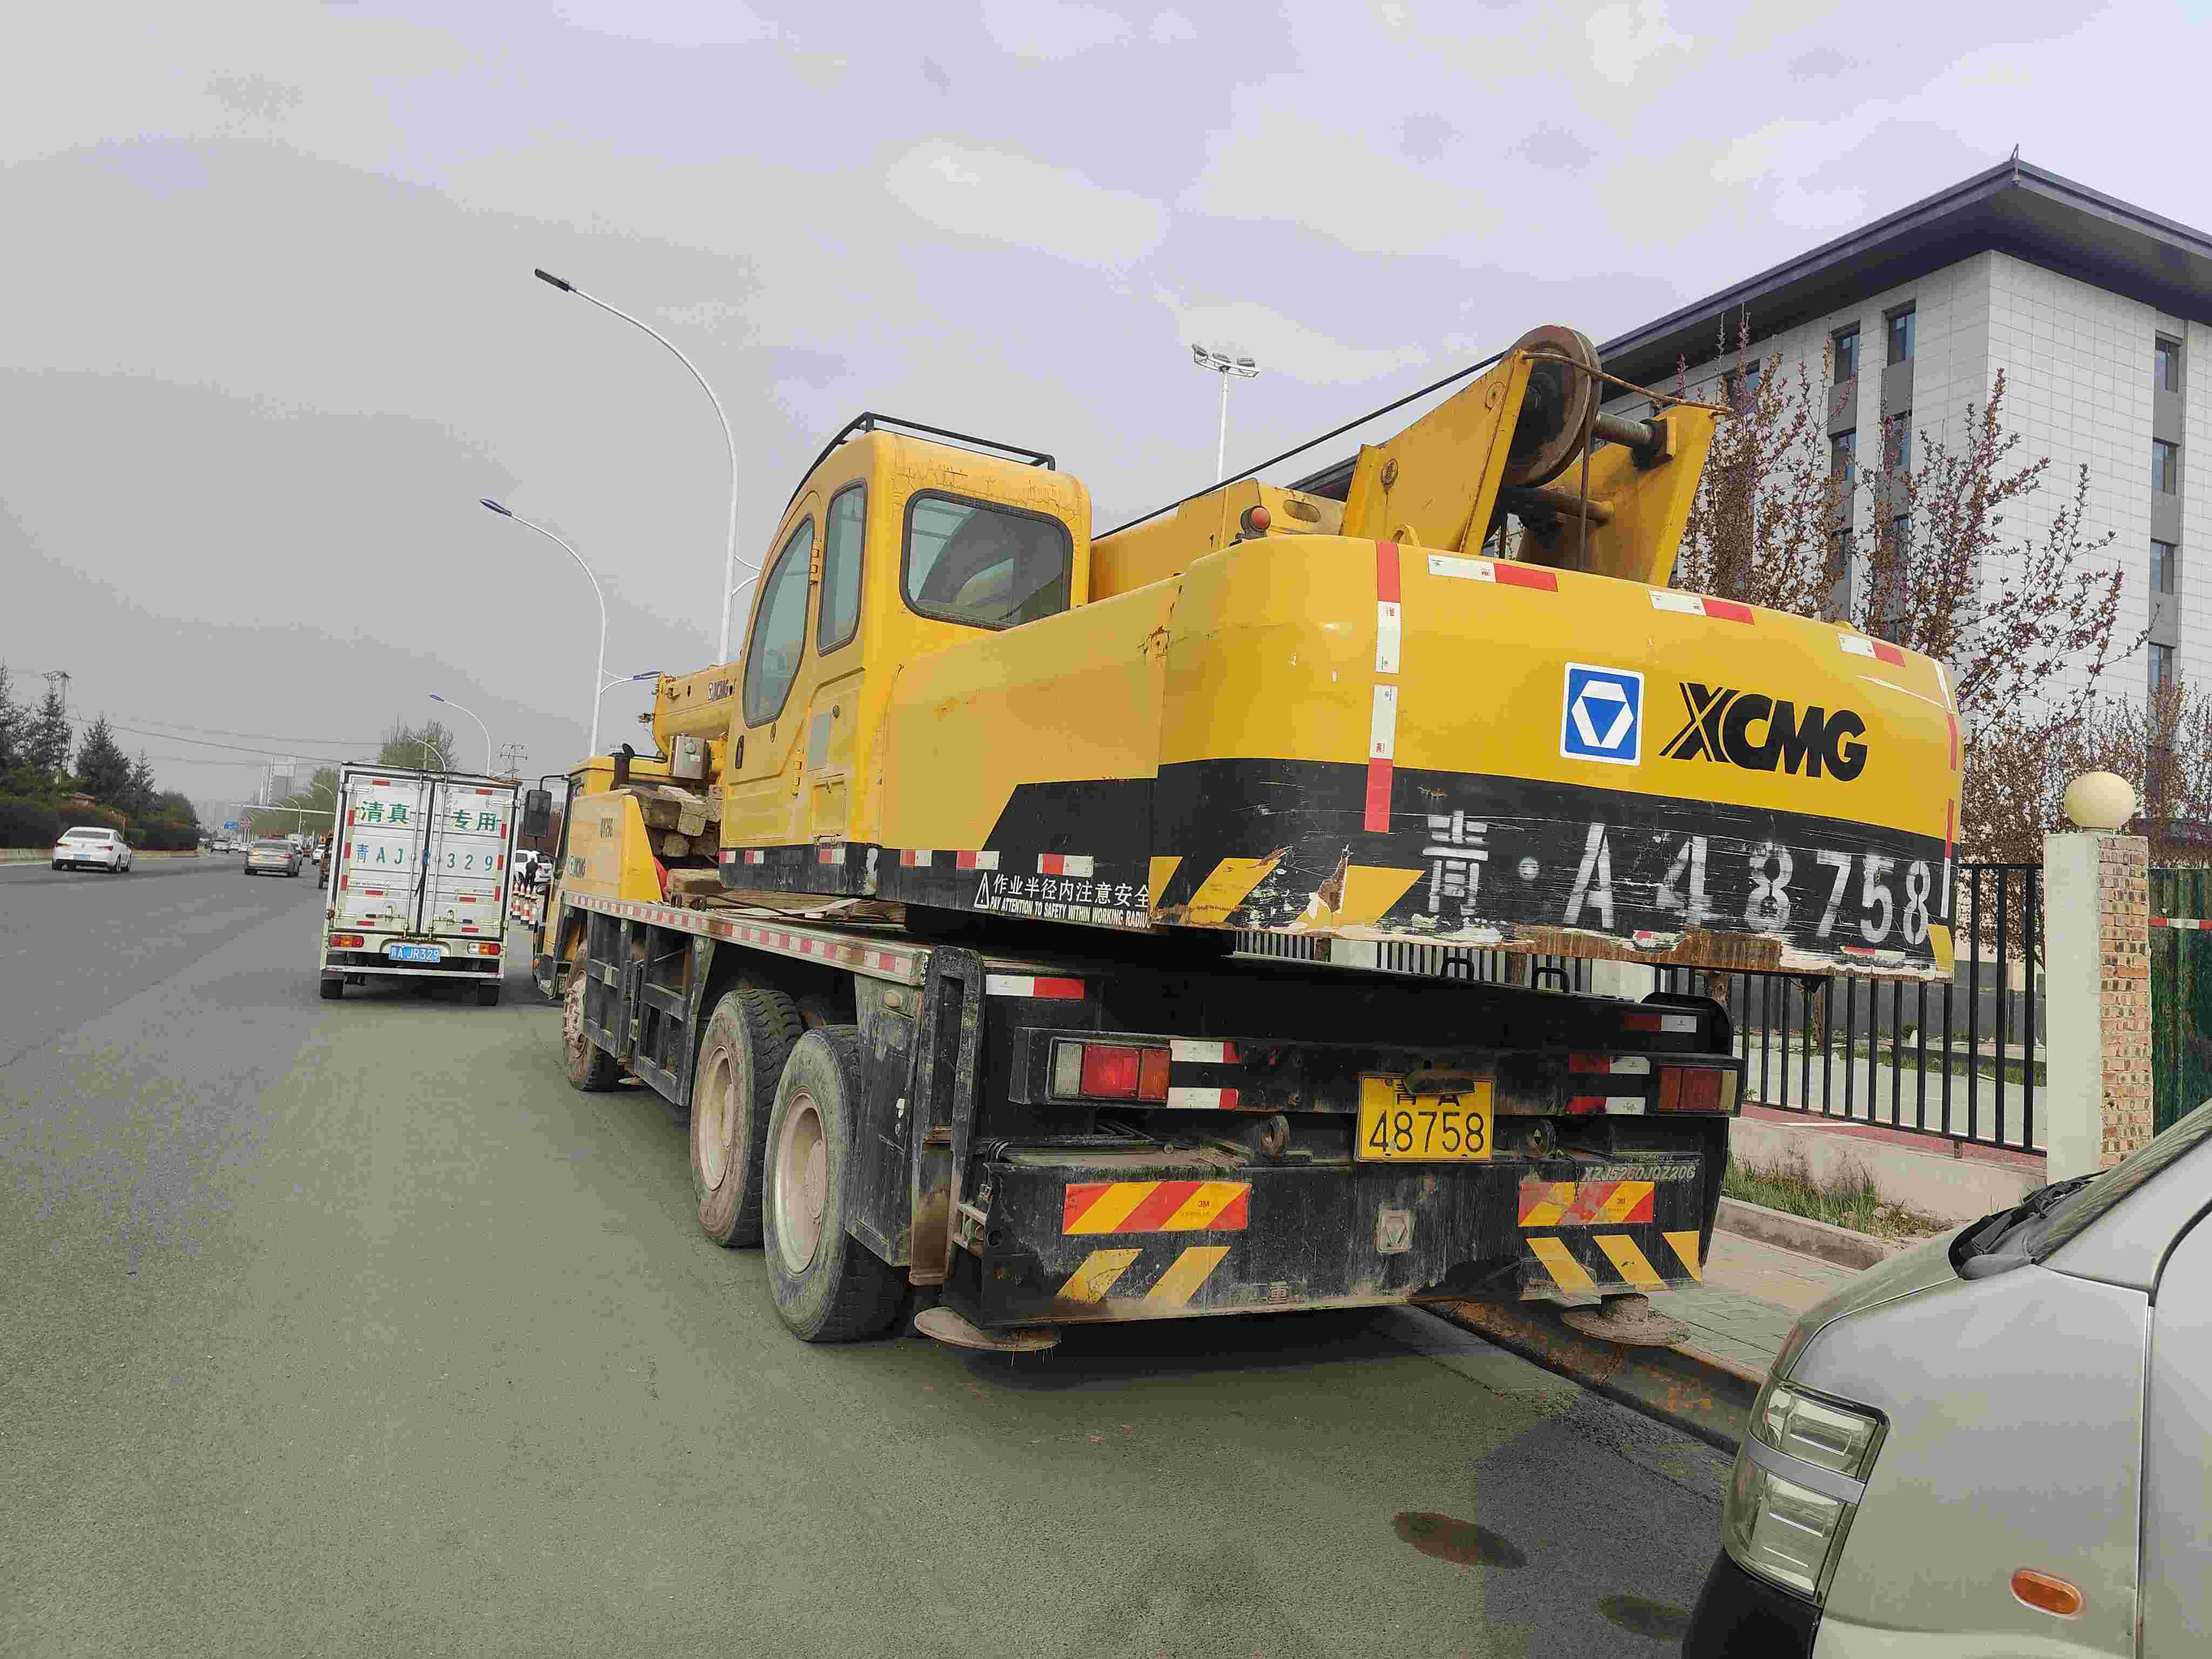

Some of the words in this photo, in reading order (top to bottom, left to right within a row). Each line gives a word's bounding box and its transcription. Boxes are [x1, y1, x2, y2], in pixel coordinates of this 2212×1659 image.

[1659, 682, 1868, 781] XCMG
[355, 800, 410, 824] 清真
[451, 809, 497, 832] 专用
[993, 872, 1150, 908] 作业半径内注意安全
[989, 895, 1002, 911] PAY
[1001, 897, 1034, 916] ATTENTION
[1035, 901, 1042, 916] TO
[1044, 902, 1067, 919] SAFETY
[1068, 905, 1090, 922] WITHIN
[1091, 907, 1123, 926] WORKING
[1125, 911, 1151, 929] RADIU
[1369, 1110, 1485, 1153] 48758
